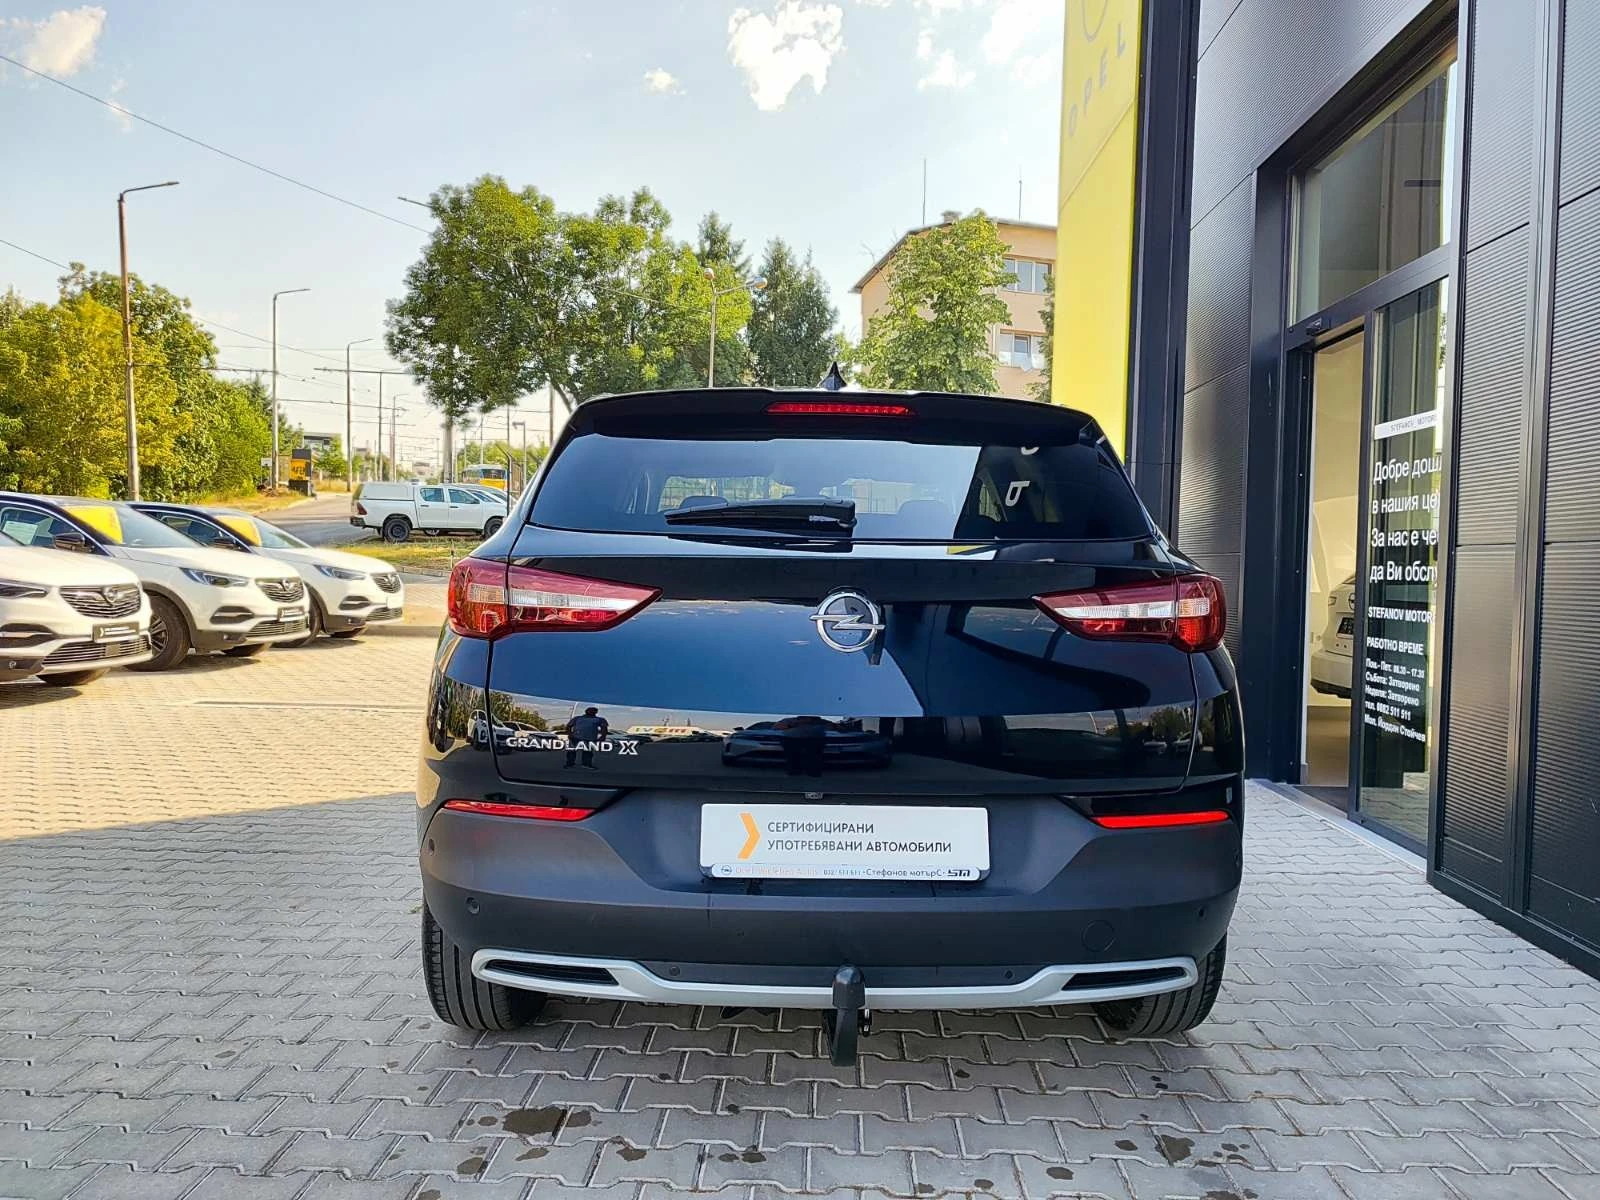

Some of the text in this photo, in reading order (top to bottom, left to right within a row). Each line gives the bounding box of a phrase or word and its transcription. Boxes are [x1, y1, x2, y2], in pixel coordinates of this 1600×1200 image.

[1067, 20, 1127, 138] OPEL
[1373, 458, 1410, 485] Добре
[1372, 493, 1440, 514] в нашия це
[1371, 527, 1385, 547] За
[1387, 530, 1408, 546] нас
[1410, 530, 1420, 546] е
[1369, 564, 1384, 583] да
[1386, 561, 1402, 580] Ви
[1368, 606, 1404, 621] STEFANOV
[1366, 636, 1425, 656] РАБОТНО ВРЕМЕ
[1388, 676, 1420, 692] Затворено
[1387, 690, 1420, 706] Затворено
[505, 736, 639, 755] GRANDLAND X
[767, 822, 875, 834] СЕРТИФИЦИРАНИ
[767, 840, 952, 853] УПОТРЕБЯВАНИ АВТОМОБИЛИ
